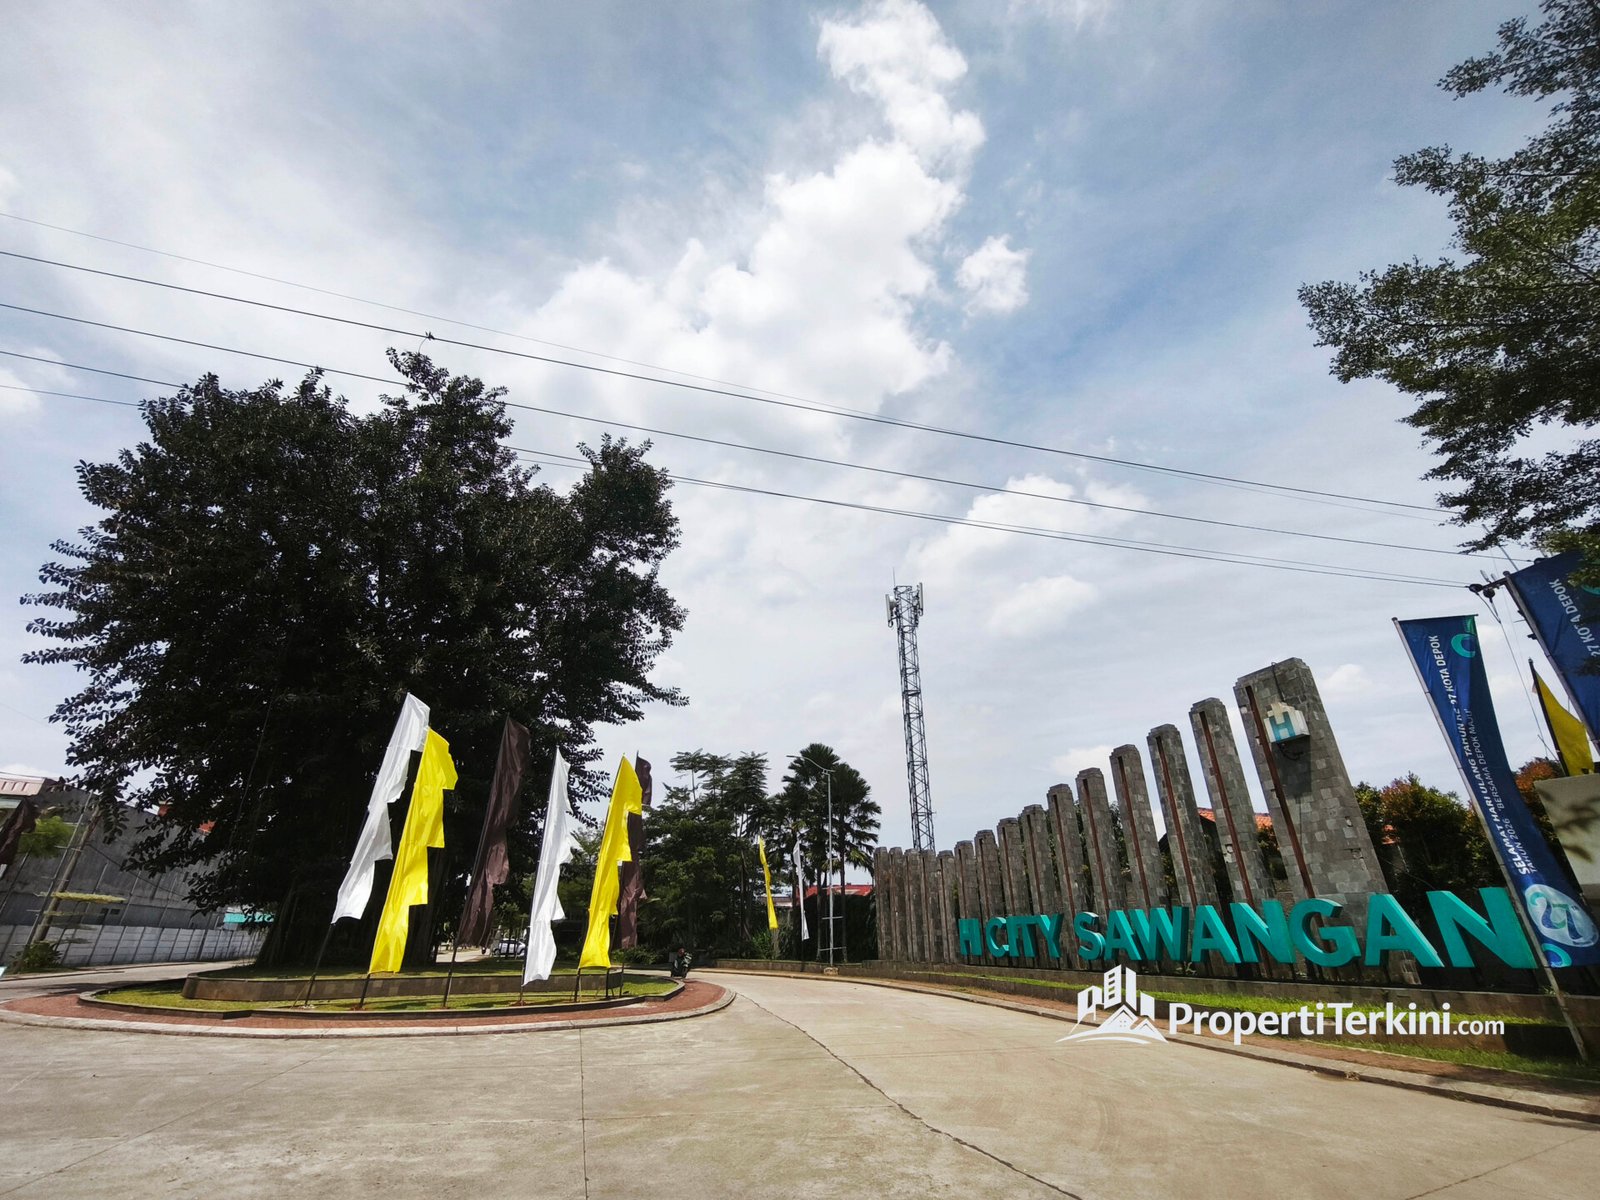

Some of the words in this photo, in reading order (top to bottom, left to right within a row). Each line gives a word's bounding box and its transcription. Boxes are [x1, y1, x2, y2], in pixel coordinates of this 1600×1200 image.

[1549, 578, 1578, 614] DEPOK
[1428, 635, 1446, 667] DEPOK
[1439, 668, 1454, 692] KOTA
[1456, 723, 1474, 757] TAHUN
[1471, 736, 1487, 764] DEPOK
[1468, 758, 1488, 794] ULANG
[1484, 796, 1501, 822] HARI
[1502, 818, 1519, 840] 2026
[1496, 824, 1531, 875] SELAMAT
[1514, 842, 1537, 873] TAHUN
[985, 914, 1063, 958] CITY
[1074, 887, 1537, 968] SAWANGAN
